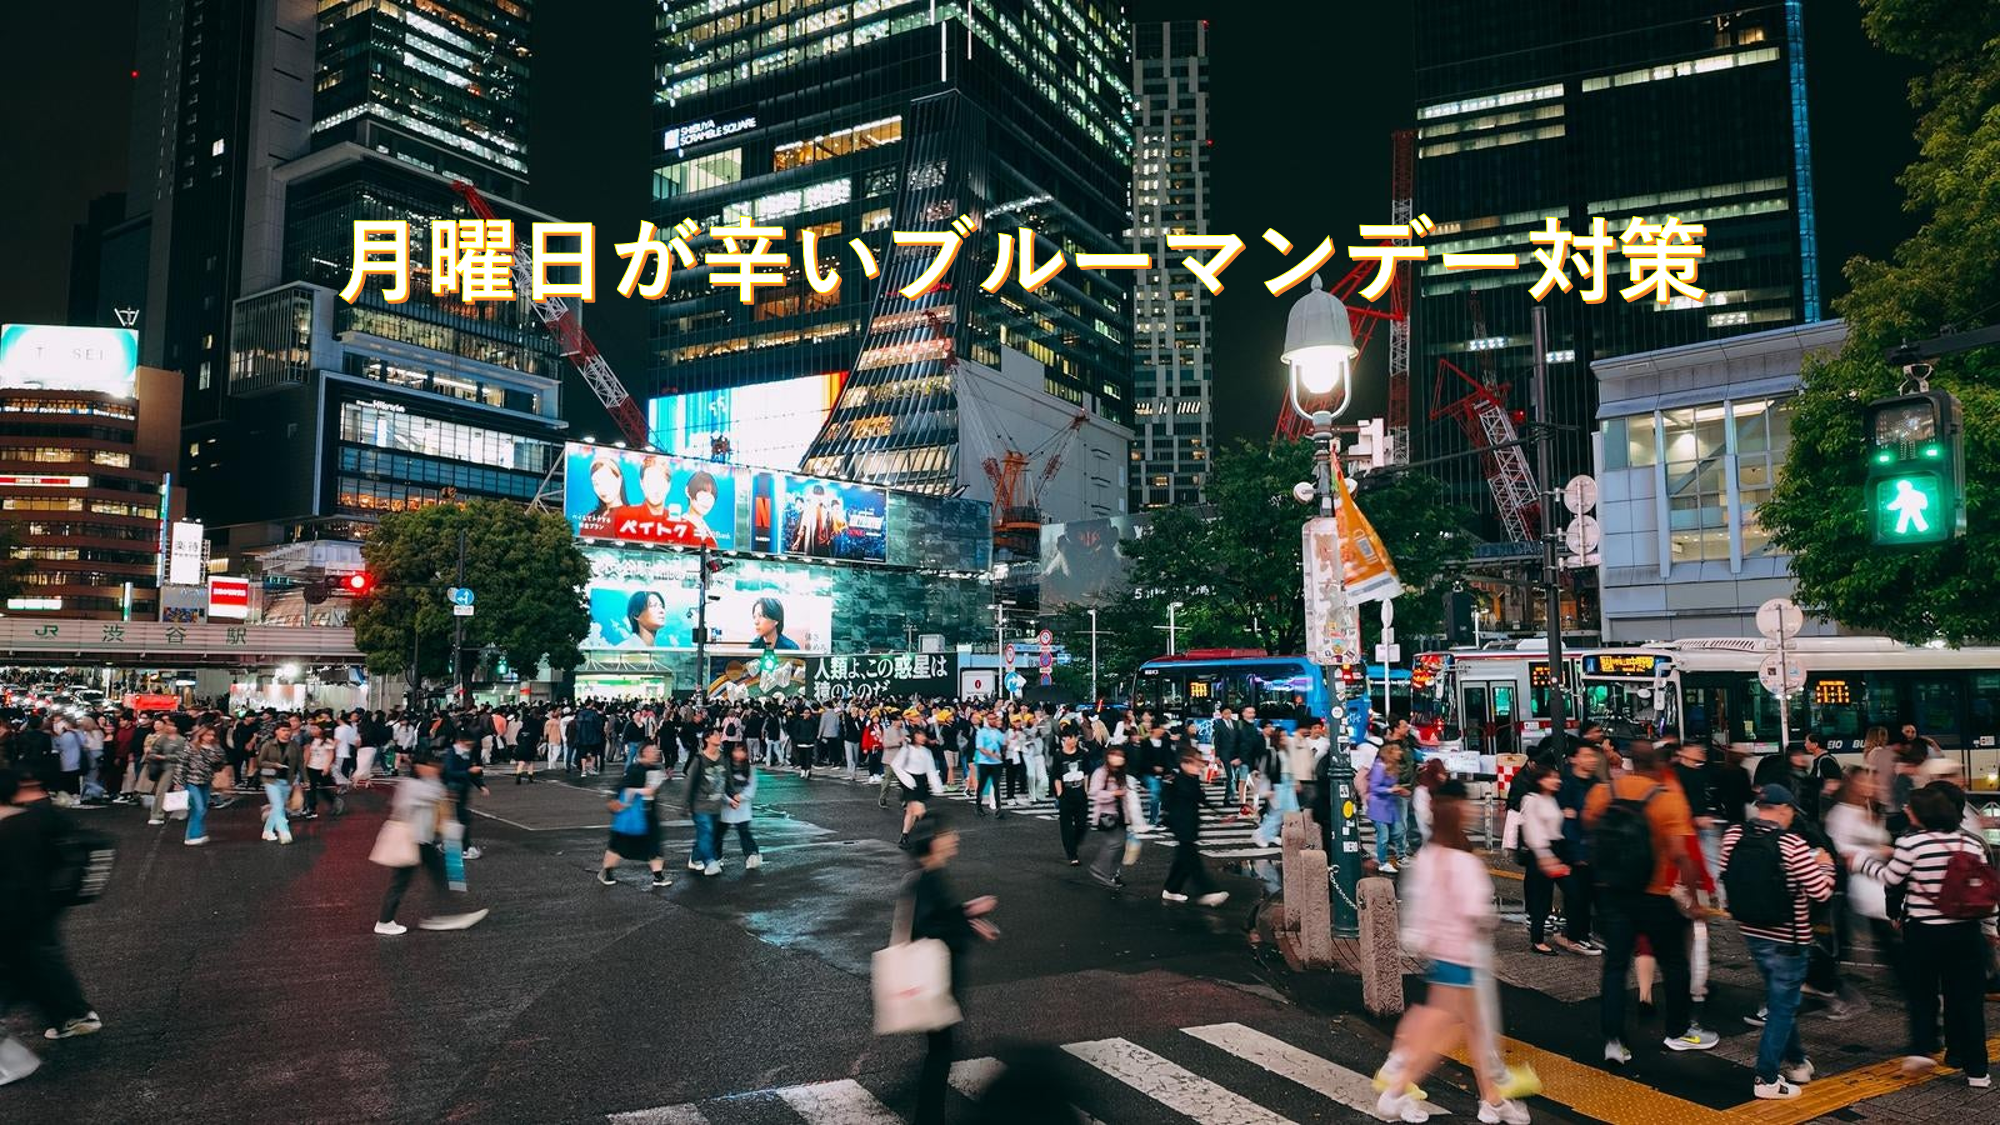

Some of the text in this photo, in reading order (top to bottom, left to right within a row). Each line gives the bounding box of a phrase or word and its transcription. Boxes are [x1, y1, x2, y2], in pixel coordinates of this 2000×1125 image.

[680, 119, 716, 136] SHIBUYA
[680, 117, 757, 146] SCRAMBLE SQUARE
[619, 519, 688, 539] ペイトク
[35, 624, 248, 645] JR 渋谷駅
[813, 654, 948, 681] 人類よ、この惑星は
